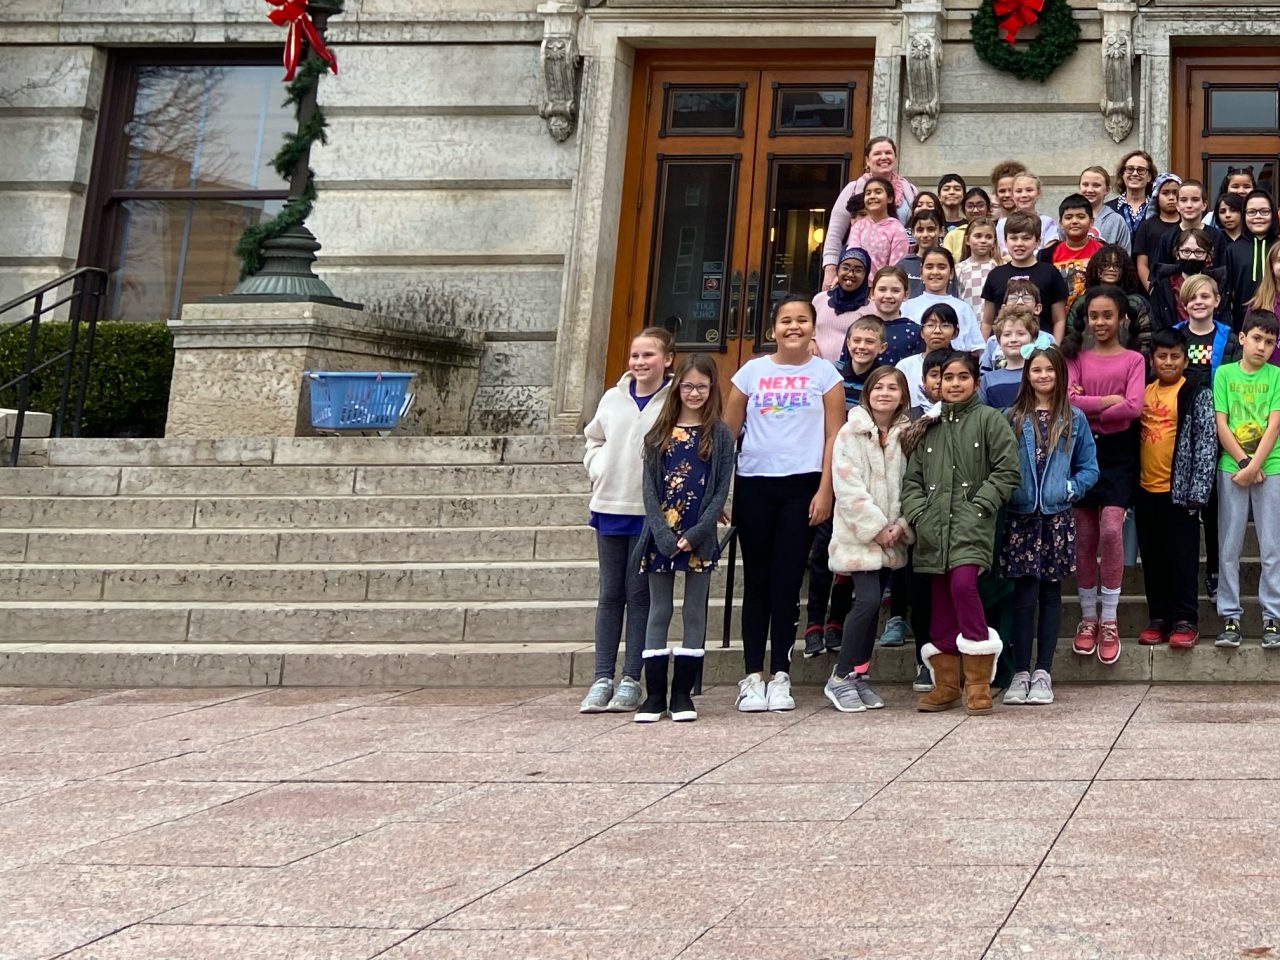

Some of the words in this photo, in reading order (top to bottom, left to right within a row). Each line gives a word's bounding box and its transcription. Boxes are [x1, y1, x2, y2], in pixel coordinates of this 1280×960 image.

[759, 376, 810, 390] NEXT
[1230, 382, 1269, 394] BEYOND
[754, 392, 811, 407] LEVEL
